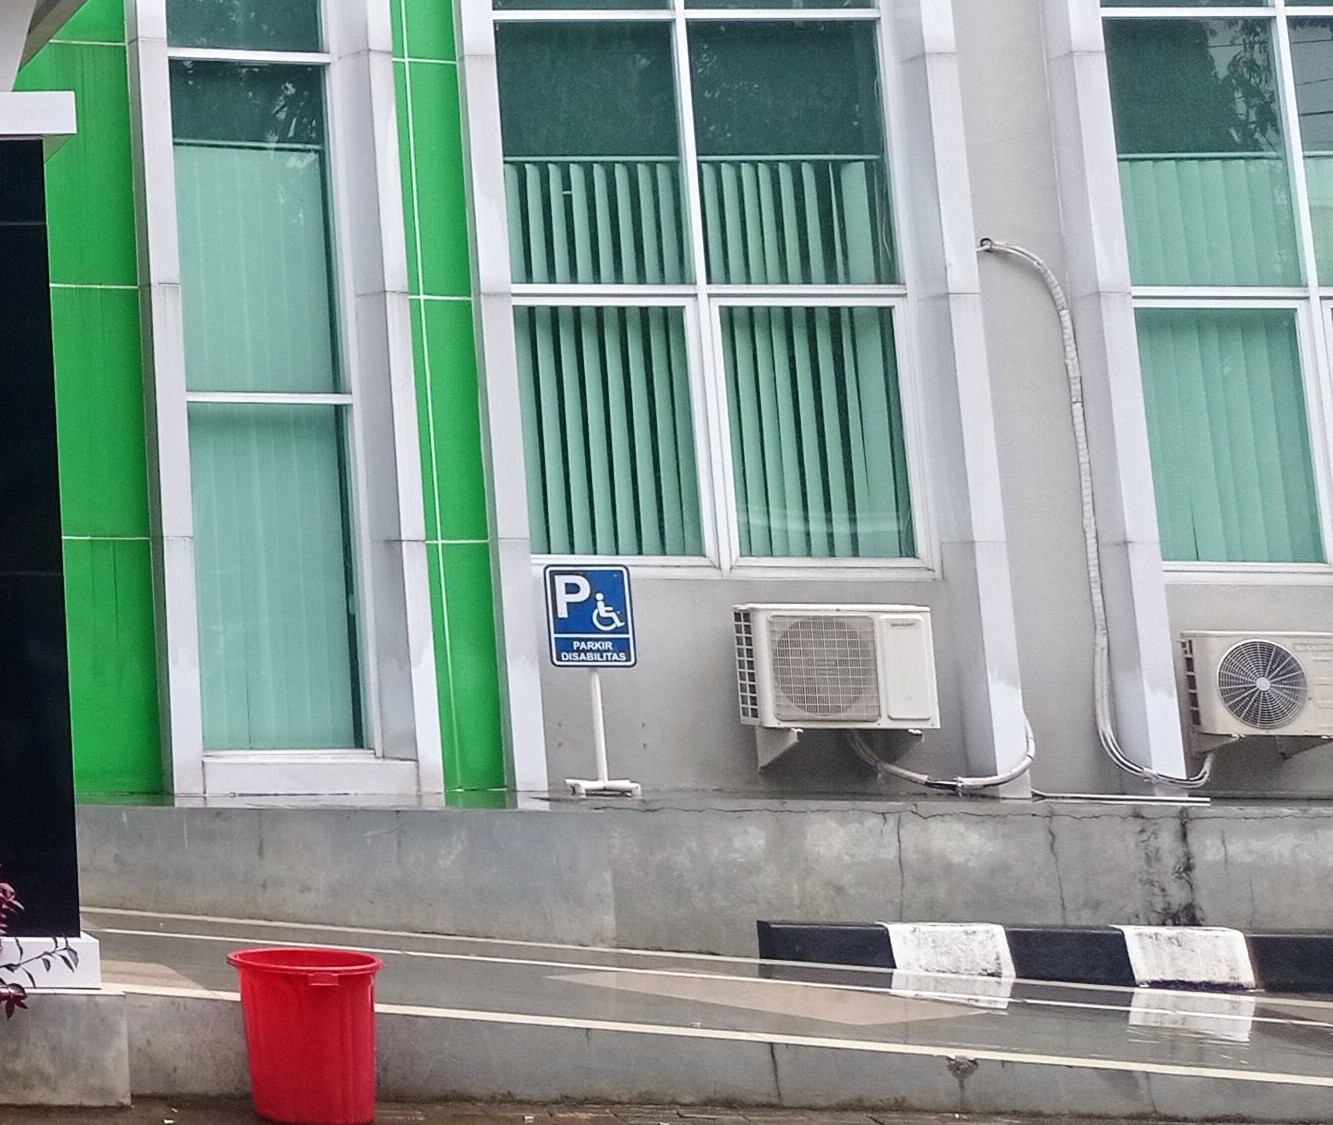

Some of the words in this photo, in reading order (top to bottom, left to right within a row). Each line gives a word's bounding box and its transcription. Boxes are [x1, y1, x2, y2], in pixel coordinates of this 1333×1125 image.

[554, 574, 591, 619] P
[573, 641, 613, 651] PARKIR
[561, 652, 627, 662] DISABILITAS
